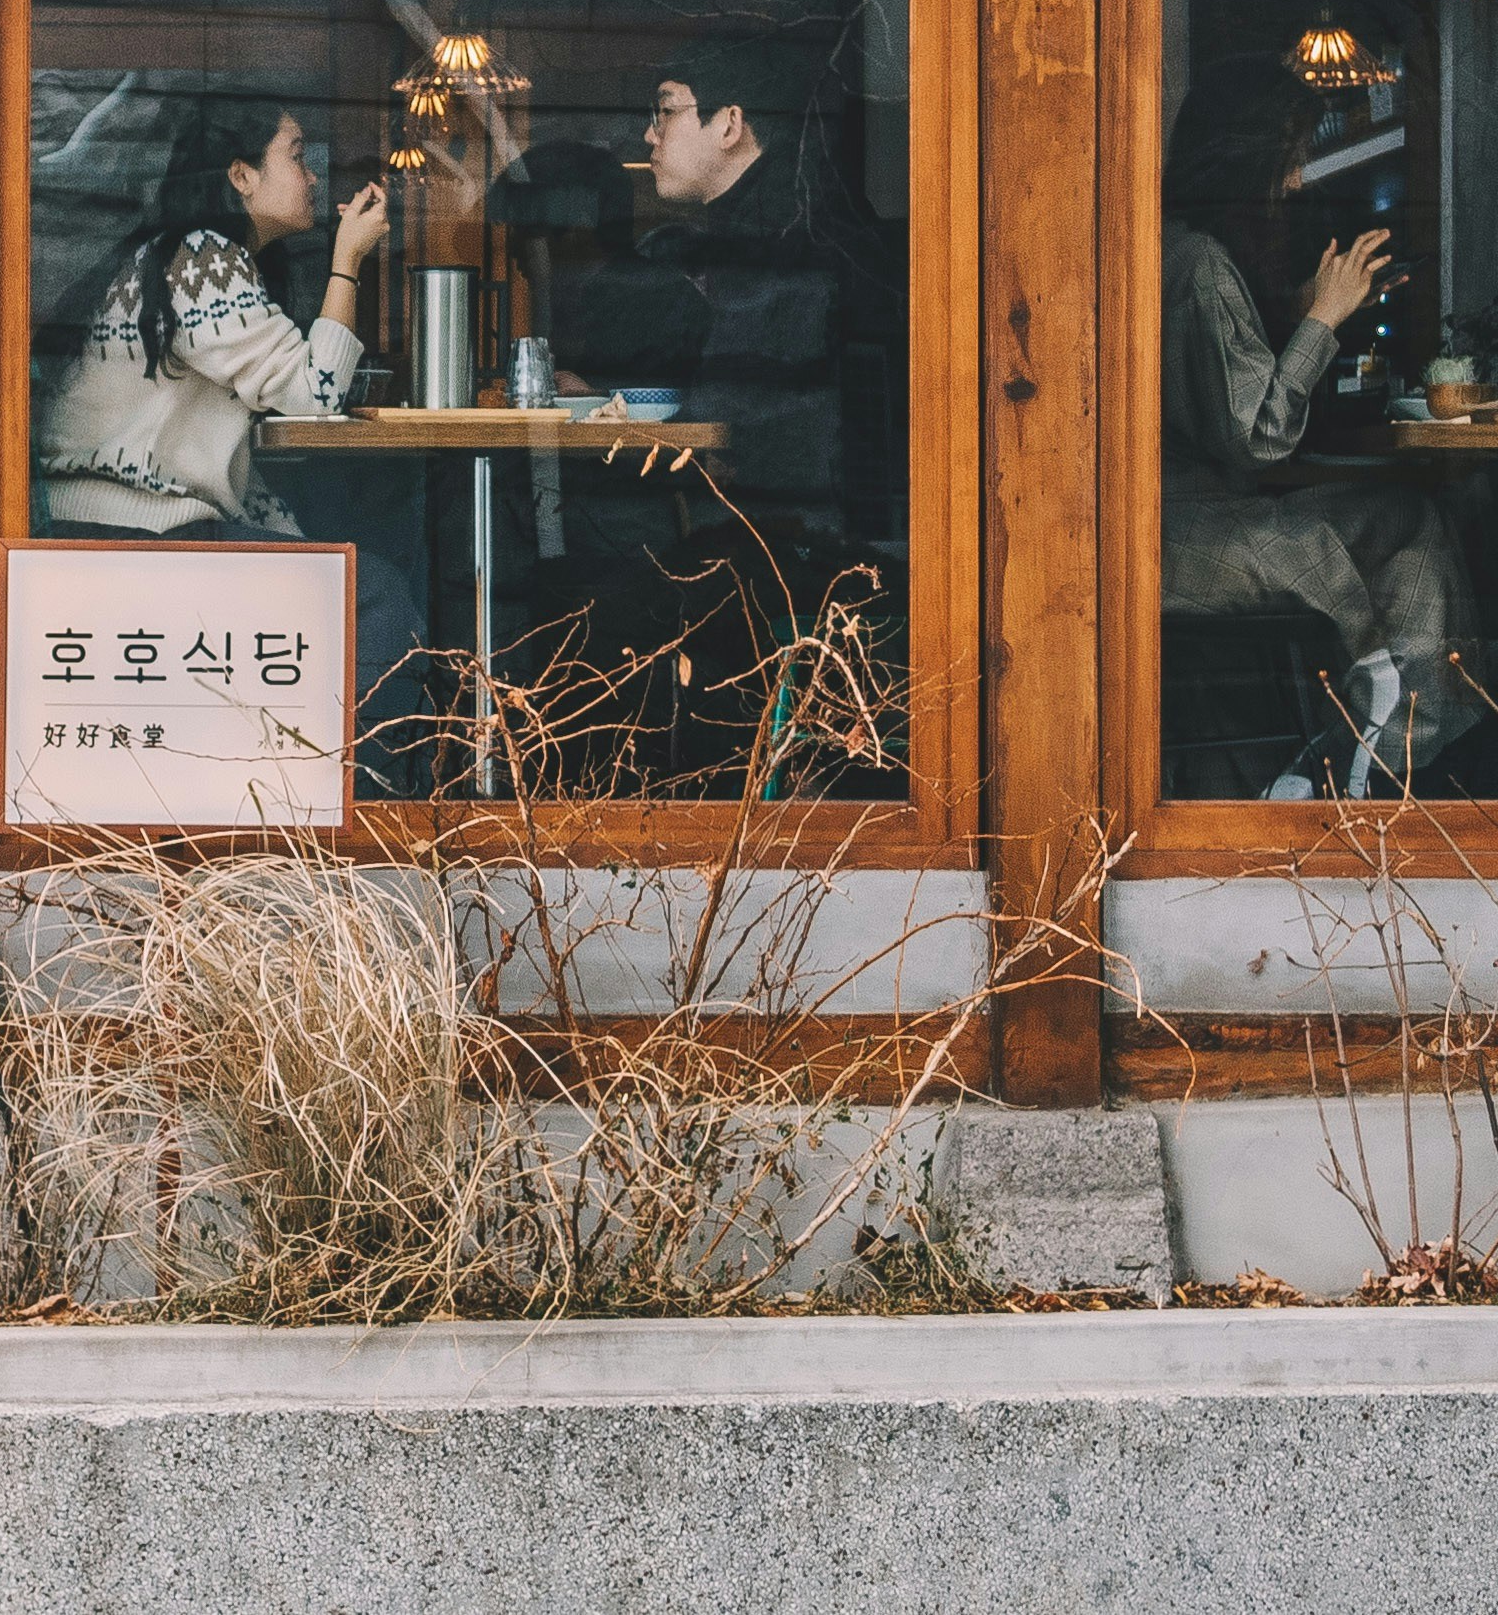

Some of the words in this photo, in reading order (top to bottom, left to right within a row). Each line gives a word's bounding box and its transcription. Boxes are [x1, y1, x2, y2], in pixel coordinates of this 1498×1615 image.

[41, 627, 310, 686] 호호식당
[43, 722, 165, 749] 好好食堂
